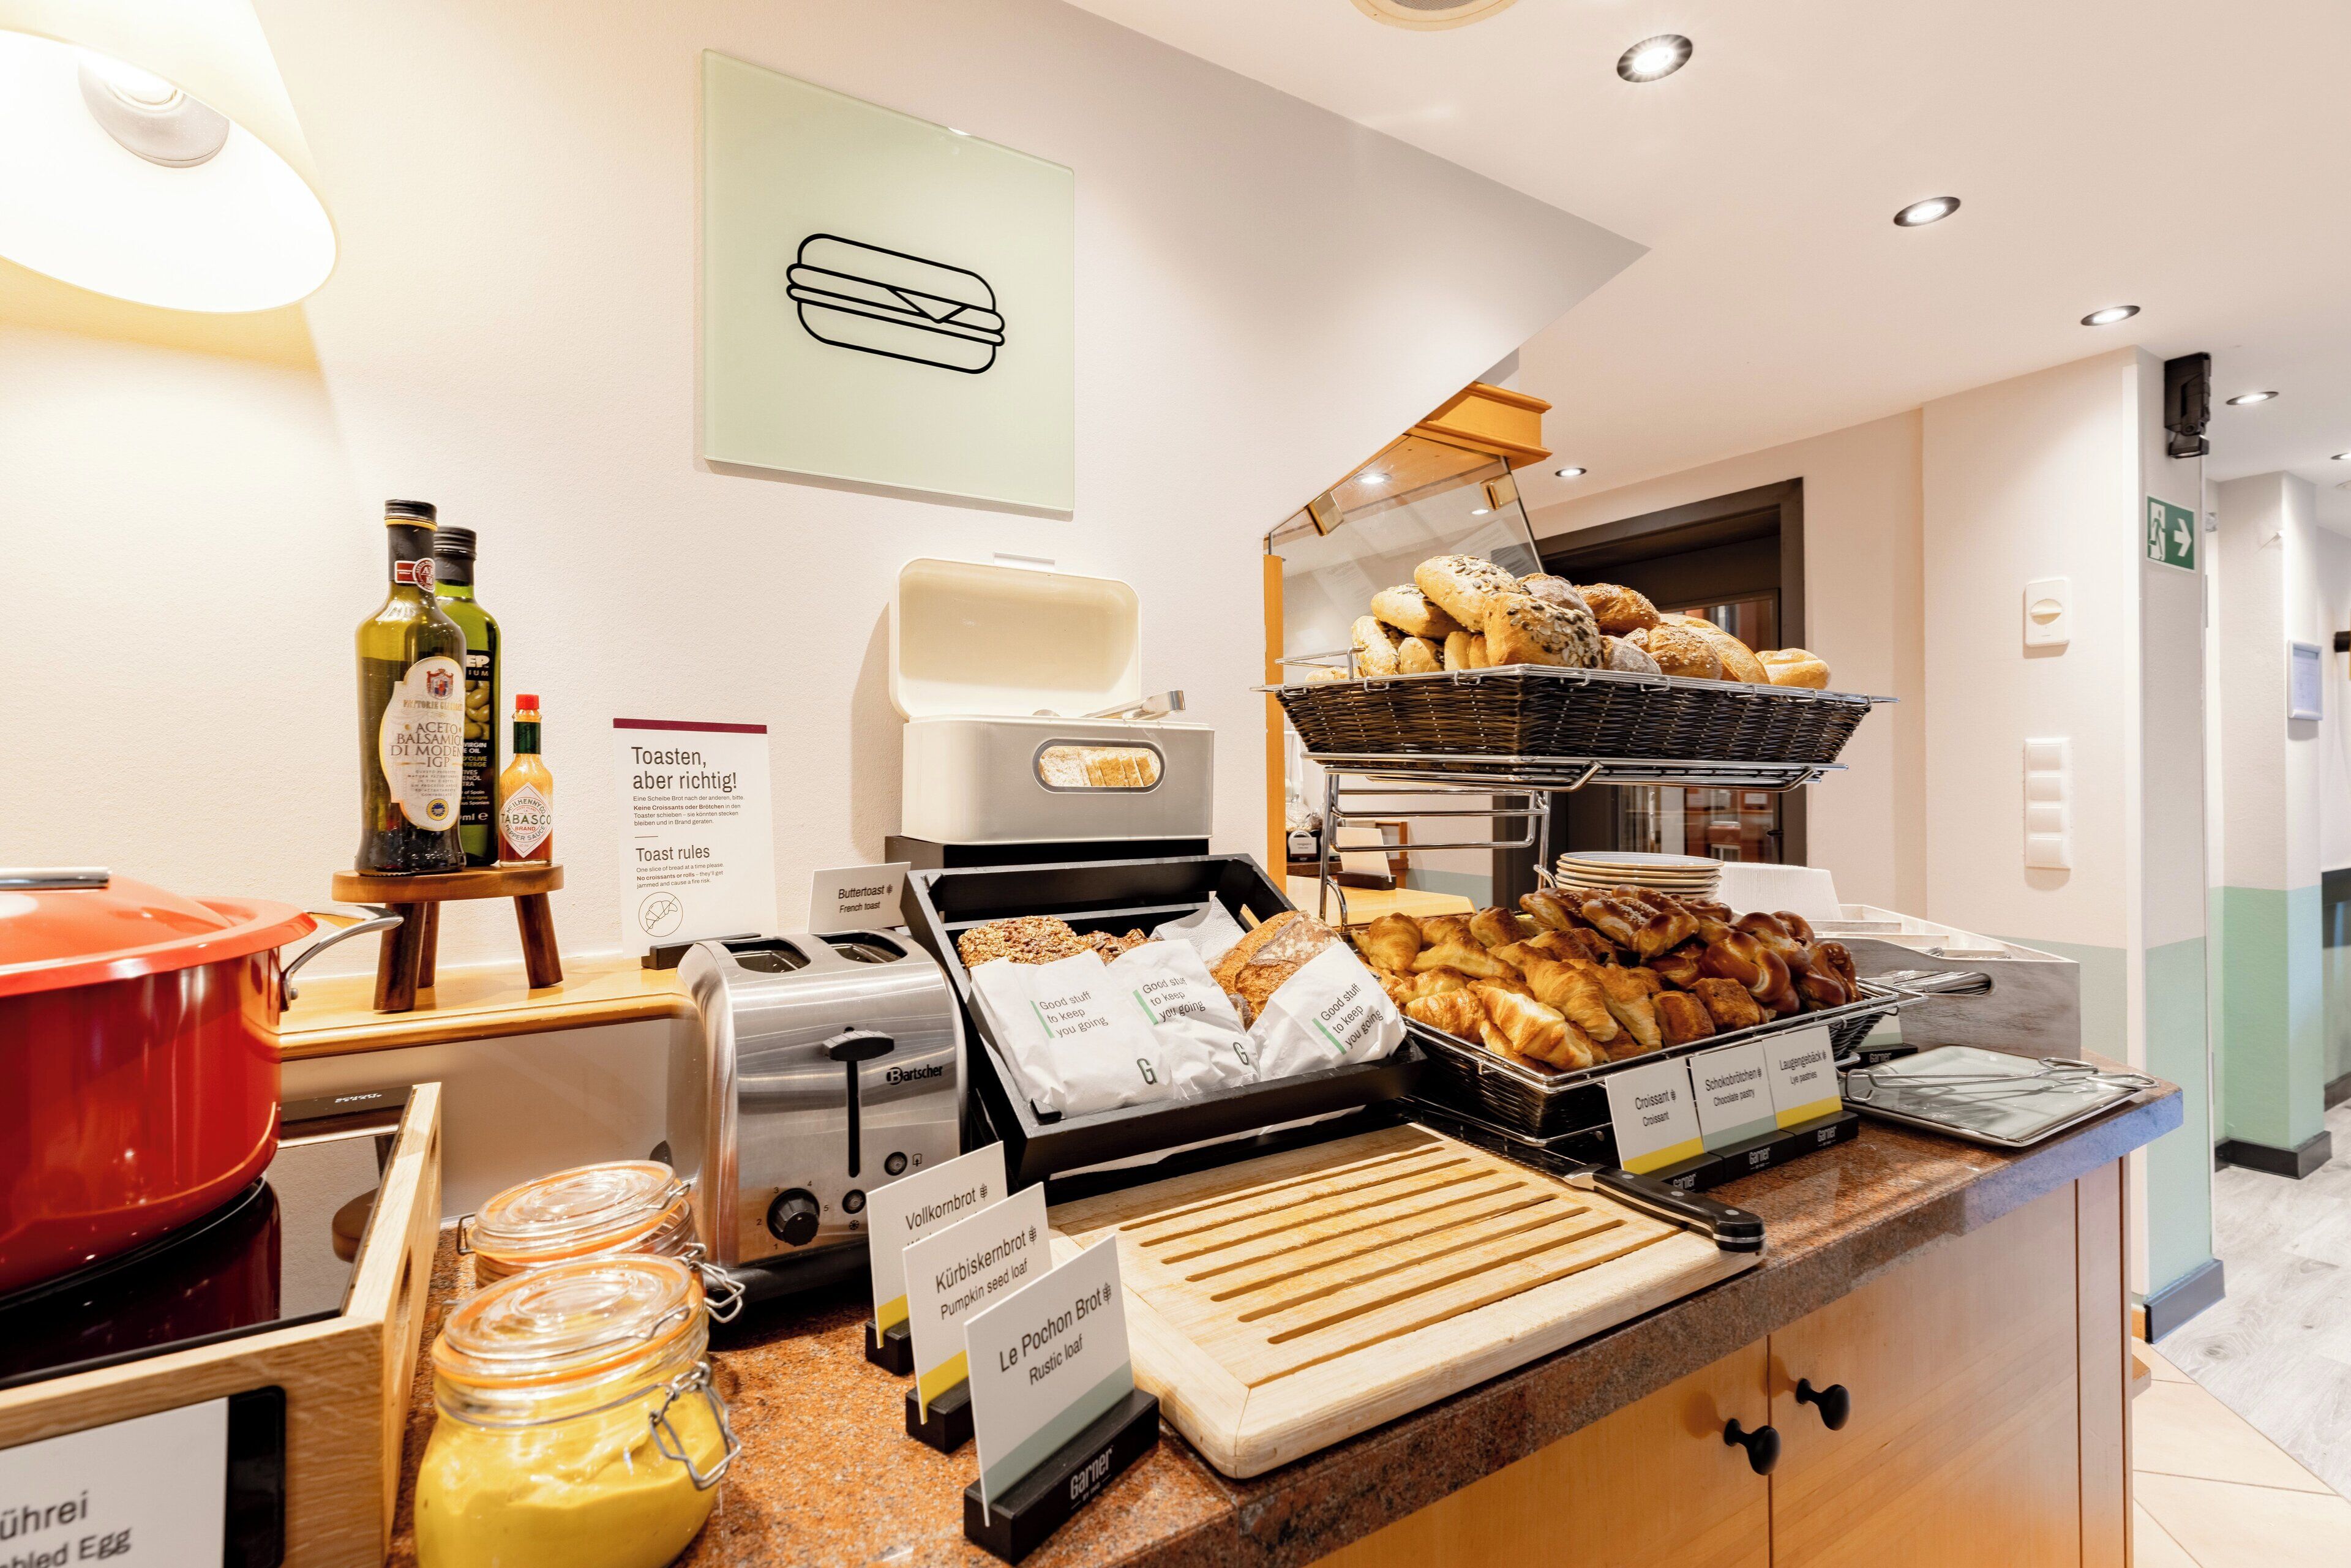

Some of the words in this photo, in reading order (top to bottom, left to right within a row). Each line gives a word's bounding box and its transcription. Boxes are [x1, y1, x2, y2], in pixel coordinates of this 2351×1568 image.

[415, 722, 457, 734] ACETO
[391, 745, 409, 756] DI
[631, 746, 707, 768] Toasten,
[427, 756, 450, 767] IGP
[633, 771, 673, 789] aber
[680, 771, 737, 793] richtig!
[501, 814, 552, 825] TABASCO
[506, 824, 525, 841] PEPPER
[527, 825, 546, 841] SAUCE
[636, 847, 673, 861] Toast
[678, 845, 710, 860] rules
[838, 885, 885, 899] Buttertoast
[839, 903, 862, 913] French
[864, 901, 880, 910] toast
[1142, 979, 1168, 994] Good
[1039, 997, 1068, 1010] Good
[1069, 991, 1091, 1003] stuff
[1150, 997, 1161, 1006] to
[1161, 991, 1185, 1002] keep
[1321, 997, 1345, 1021] Good
[1343, 983, 1362, 1002] stuff
[1047, 1015, 1058, 1023] to
[1059, 1009, 1086, 1021] keep
[1159, 1008, 1176, 1022] you
[1179, 1001, 1206, 1016] going
[1332, 1023, 1344, 1033] to
[1341, 1005, 1363, 1026] keep
[1056, 1026, 1076, 1038] you
[1078, 1017, 1109, 1032] going
[1345, 1030, 1362, 1049] you
[1361, 1009, 1384, 1035] going
[1232, 1041, 1250, 1066] G
[1779, 1050, 1823, 1070] Laugengebäck
[1869, 1052, 1892, 1063] Garner
[886, 1064, 943, 1085] Bartscher
[1136, 1058, 1158, 1085] G
[1705, 1069, 1757, 1091] Schokobrötchen
[1790, 1076, 1799, 1086] Lye
[1799, 1070, 1817, 1084] pastries
[1635, 1090, 1670, 1110] Croissant
[1714, 1092, 1739, 1106] Chocolate
[1739, 1089, 1755, 1101] pastry
[1643, 1111, 1670, 1127] Croissant
[906, 1188, 976, 1231] Vollkornbrot
[936, 1230, 1026, 1294] Kürbiskernbrot
[940, 1285, 984, 1320] Pumpkin
[987, 1269, 1010, 1293] seed
[1011, 1258, 1027, 1280] loaf
[1000, 1347, 1018, 1373] Le
[1022, 1311, 1073, 1357] Pochon
[1075, 1288, 1101, 1321] Brot
[1029, 1352, 1063, 1386] Rustic
[1064, 1334, 1082, 1360] loaf
[1070, 1448, 1112, 1500] Garner
[79, 1527, 132, 1560] Egg
